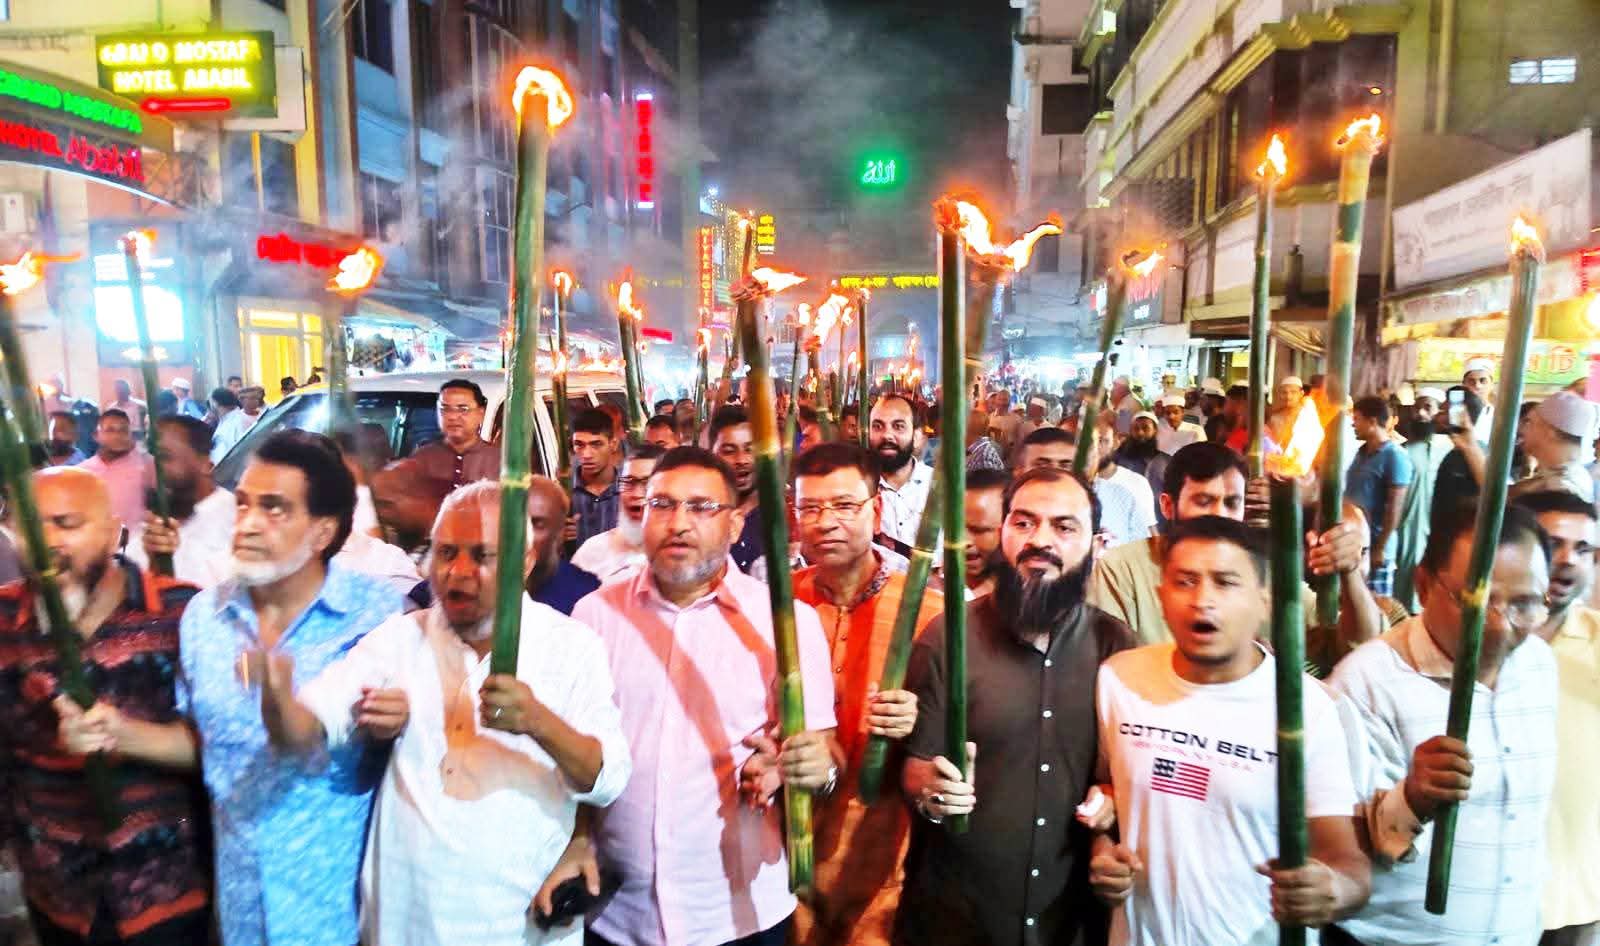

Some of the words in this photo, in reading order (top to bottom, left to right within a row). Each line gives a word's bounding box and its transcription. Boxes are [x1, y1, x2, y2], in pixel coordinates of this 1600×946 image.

[113, 69, 178, 93] HOTEL
[182, 67, 253, 91] ABABIL
[0, 118, 63, 158] HOTEL
[1119, 723, 1209, 749] COTTON
[1216, 740, 1280, 764] BELT
